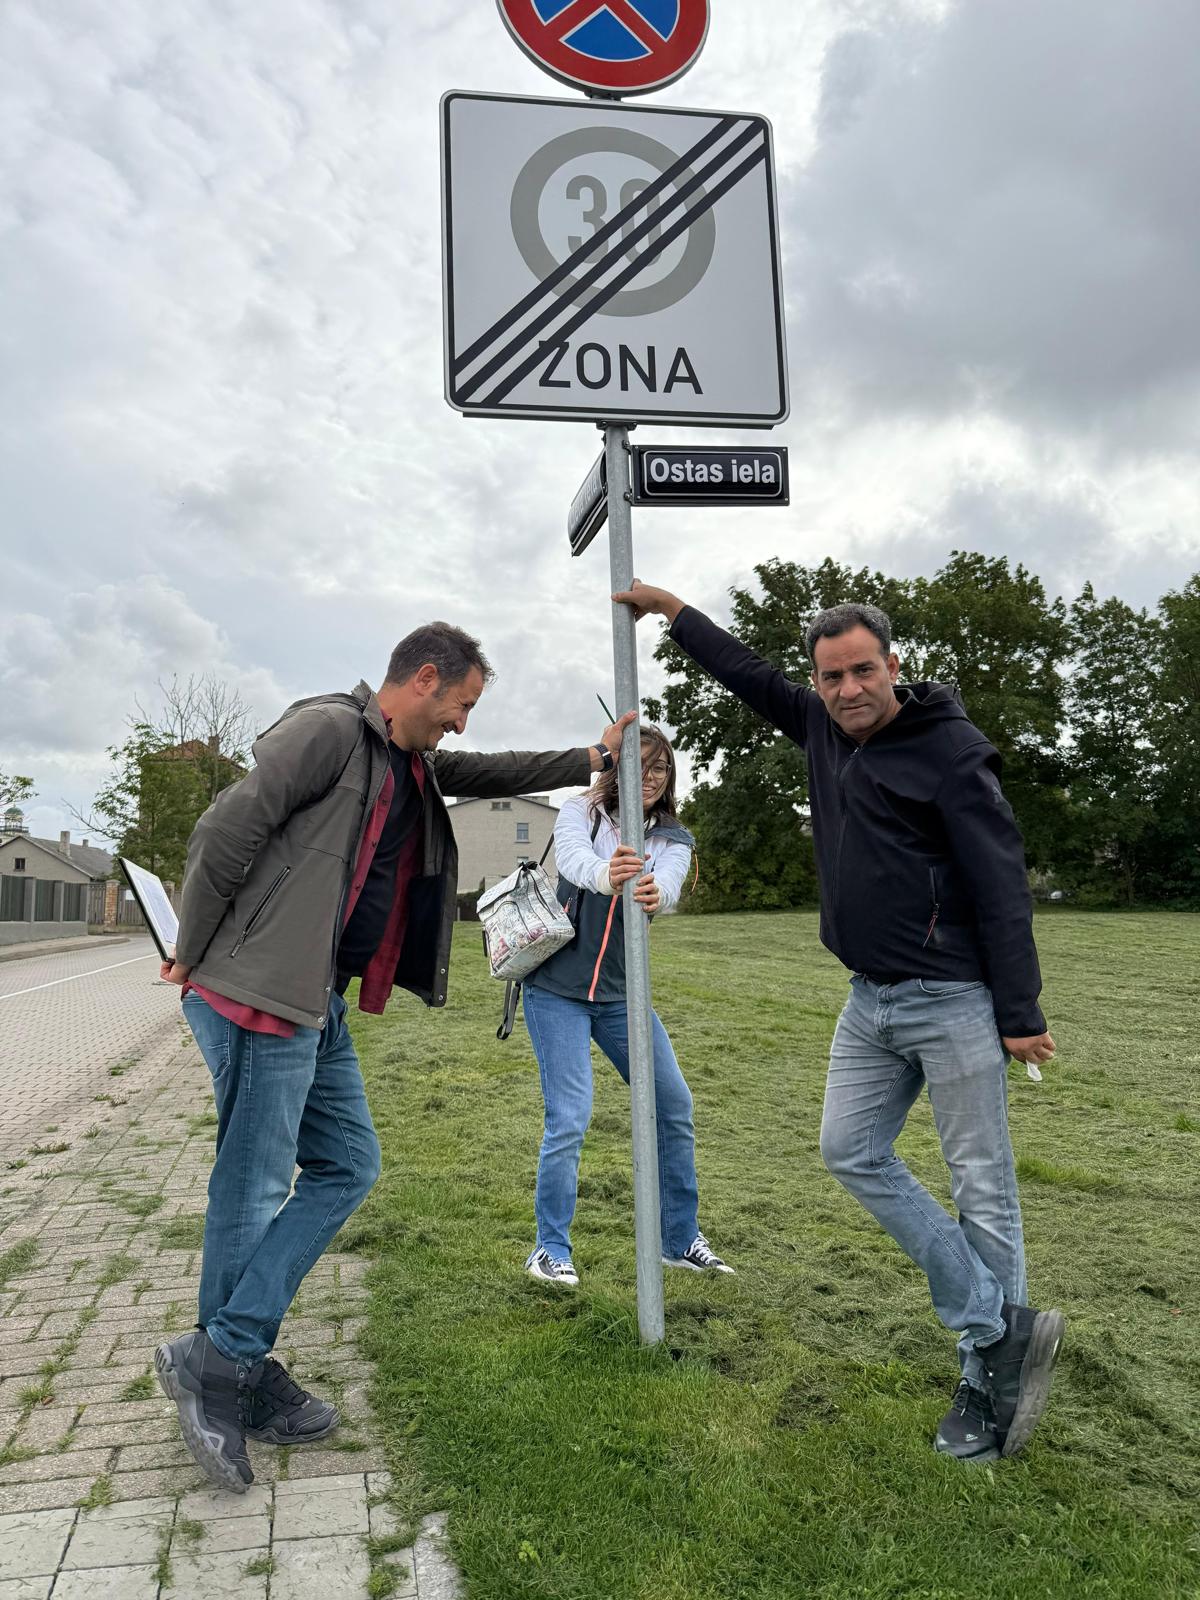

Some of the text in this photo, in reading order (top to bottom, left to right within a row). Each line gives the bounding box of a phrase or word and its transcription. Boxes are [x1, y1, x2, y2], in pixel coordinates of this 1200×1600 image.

[566, 175, 662, 267] 30
[538, 340, 704, 395] ZONA
[650, 457, 776, 484] Ostas iela
